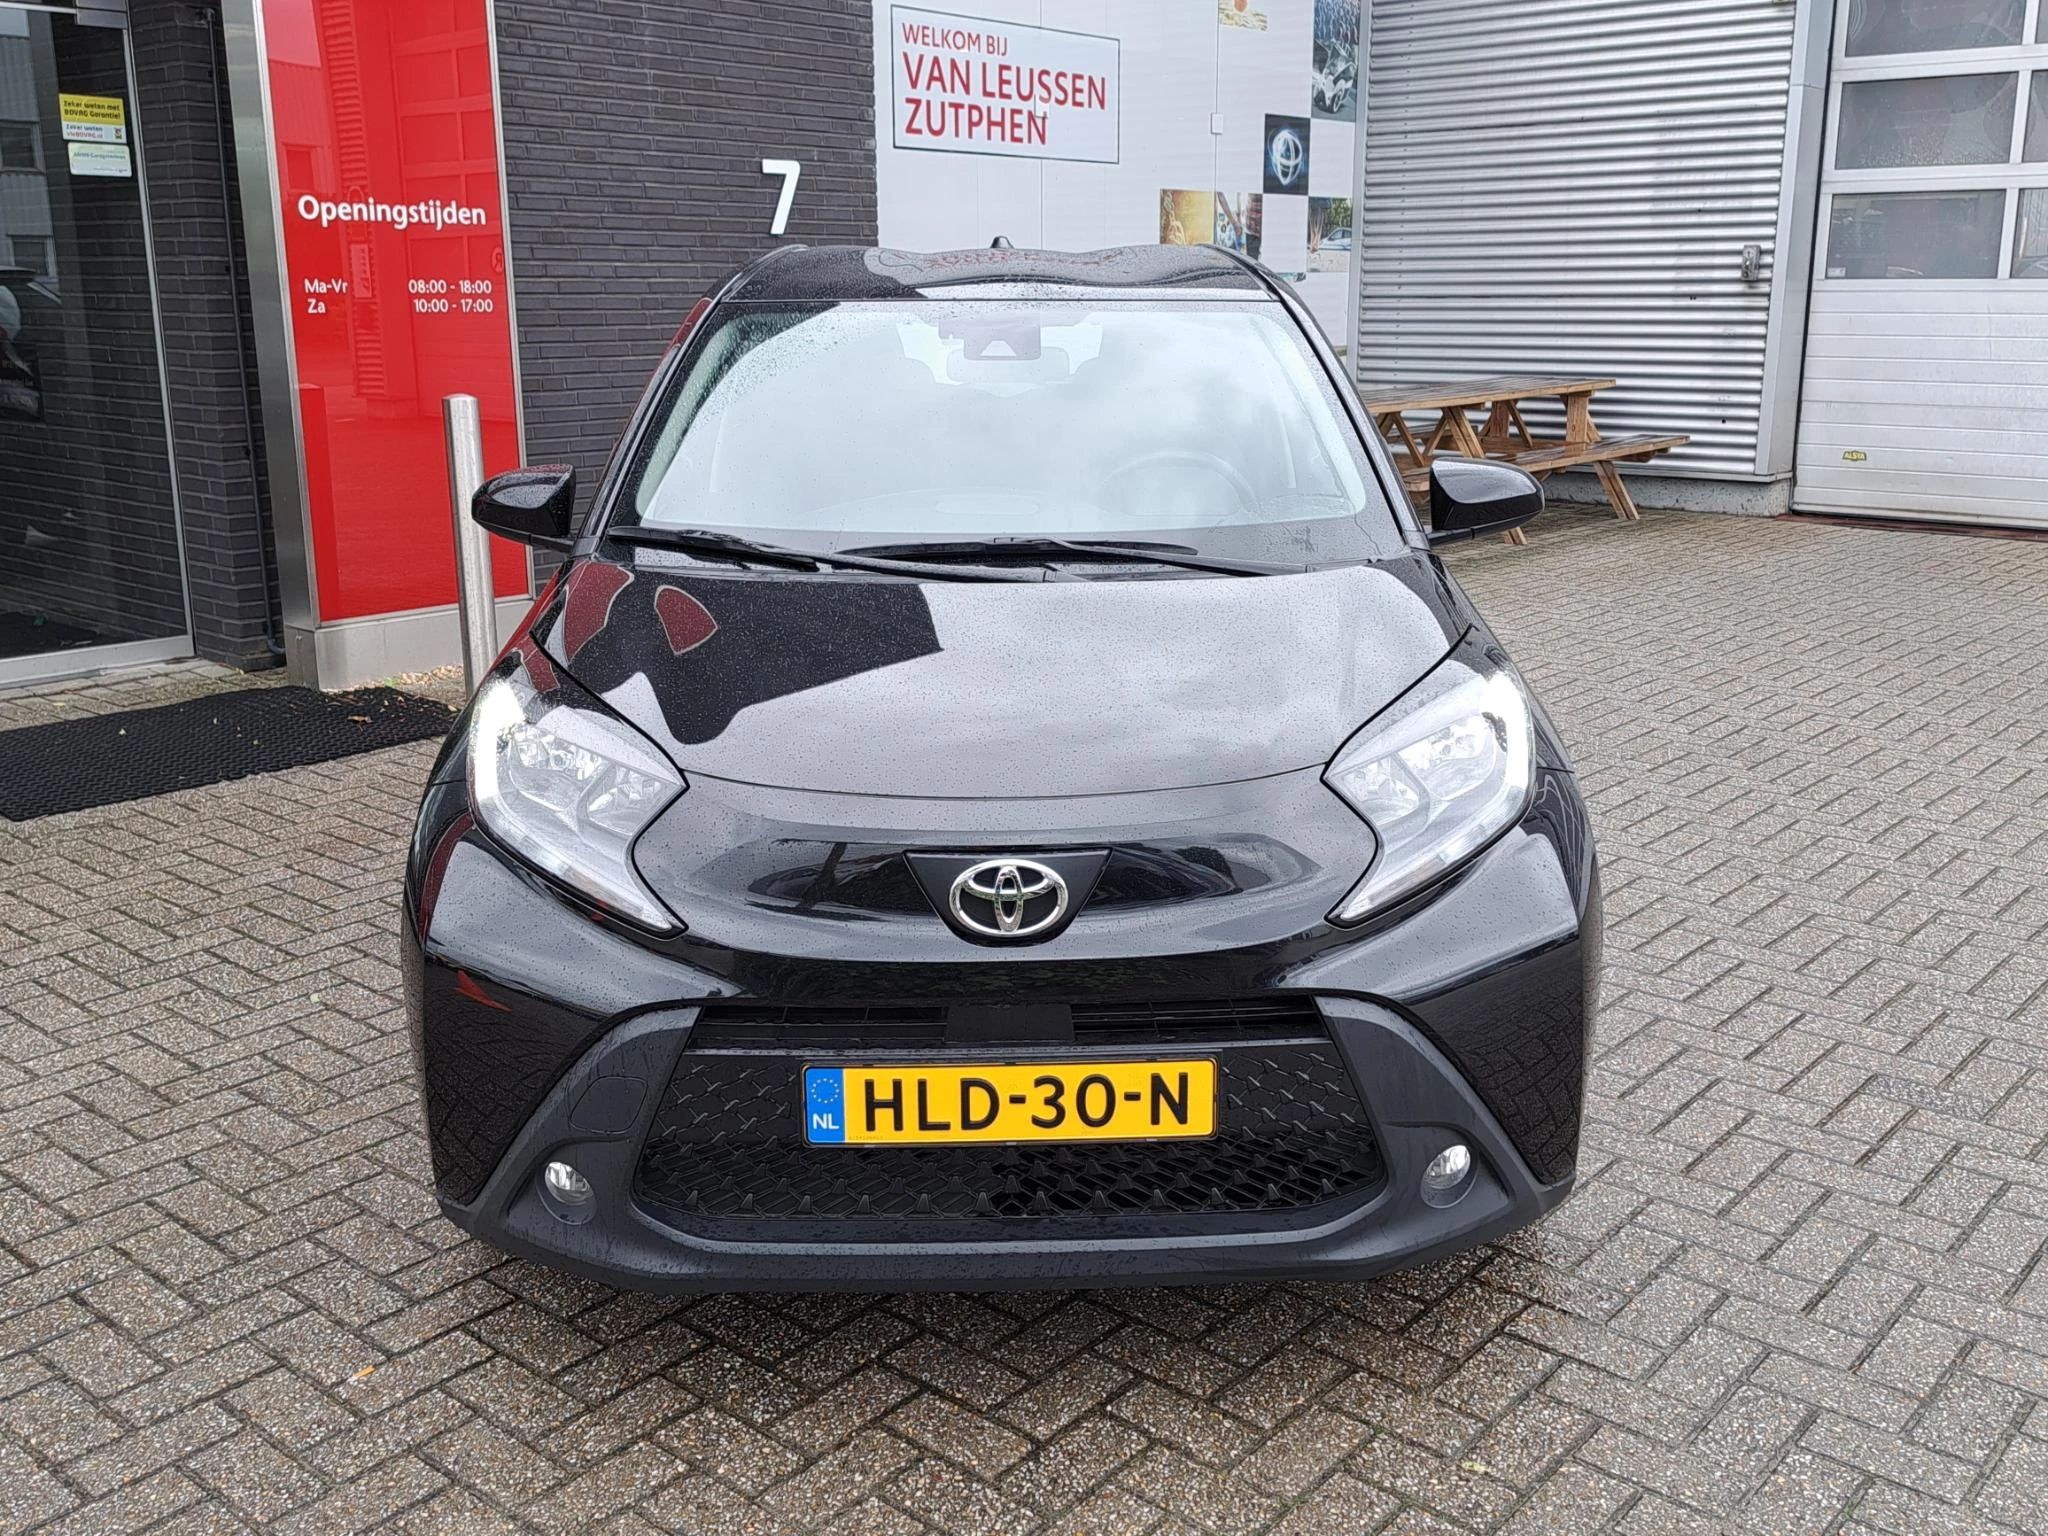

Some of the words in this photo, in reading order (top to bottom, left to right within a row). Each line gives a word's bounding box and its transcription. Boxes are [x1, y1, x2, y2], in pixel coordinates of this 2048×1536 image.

[902, 22, 981, 53] WELKOM
[986, 35, 1008, 56] BIJ
[903, 51, 971, 96] VAN
[982, 61, 1106, 110] LEUSSEN
[905, 97, 1047, 145] ZUTPHEN
[298, 195, 487, 231] Openingstijden
[762, 159, 800, 235] 7
[304, 278, 348, 294] Ma-Vr
[408, 280, 447, 294] 08:00
[459, 280, 492, 294] 18:00
[307, 298, 326, 314] Za
[414, 299, 449, 313] 10:00
[461, 299, 494, 313] 17:00
[812, 1113, 840, 1130] NL
[863, 1072, 1189, 1132] HLD-30-N
